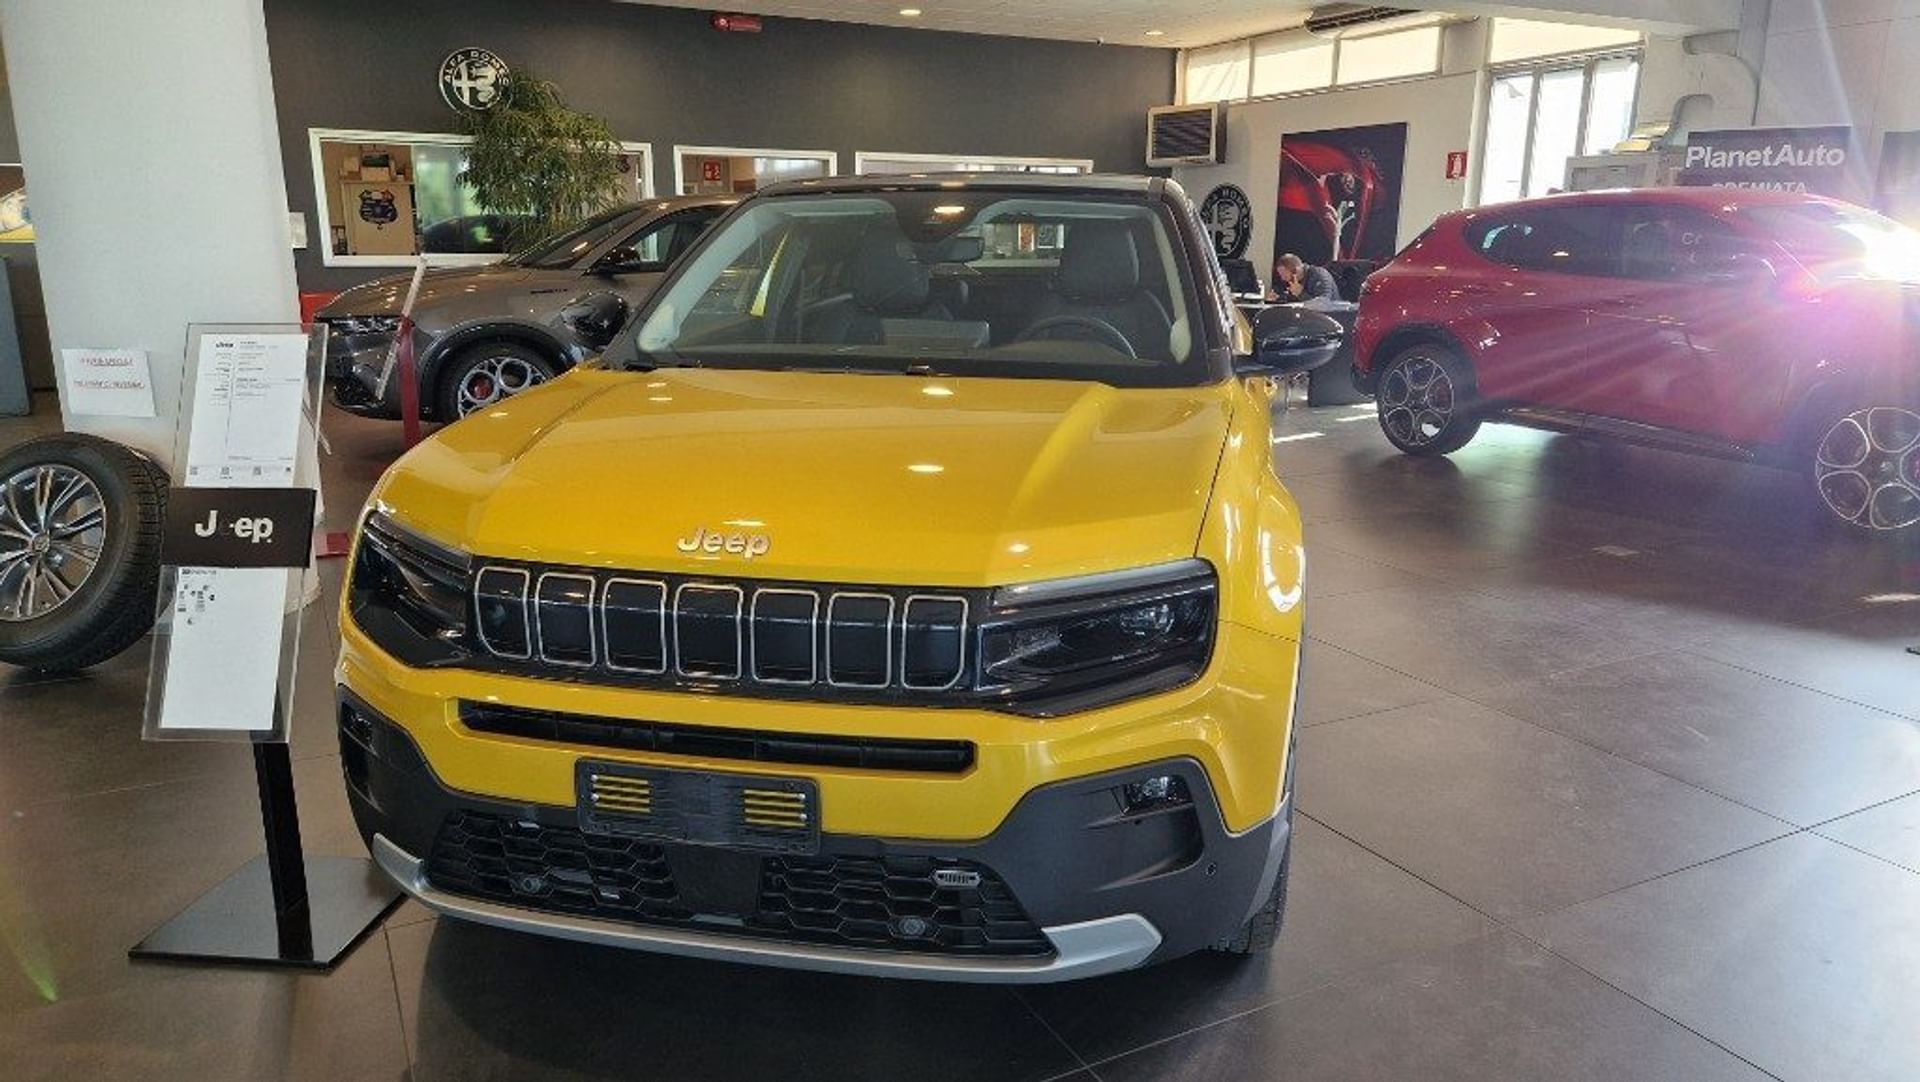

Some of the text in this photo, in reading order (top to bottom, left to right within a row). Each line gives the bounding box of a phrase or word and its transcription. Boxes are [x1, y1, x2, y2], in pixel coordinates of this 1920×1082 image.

[1685, 144, 1845, 169] PlanetAuto
[194, 509, 274, 543] Jep
[677, 526, 770, 559] Jeep
